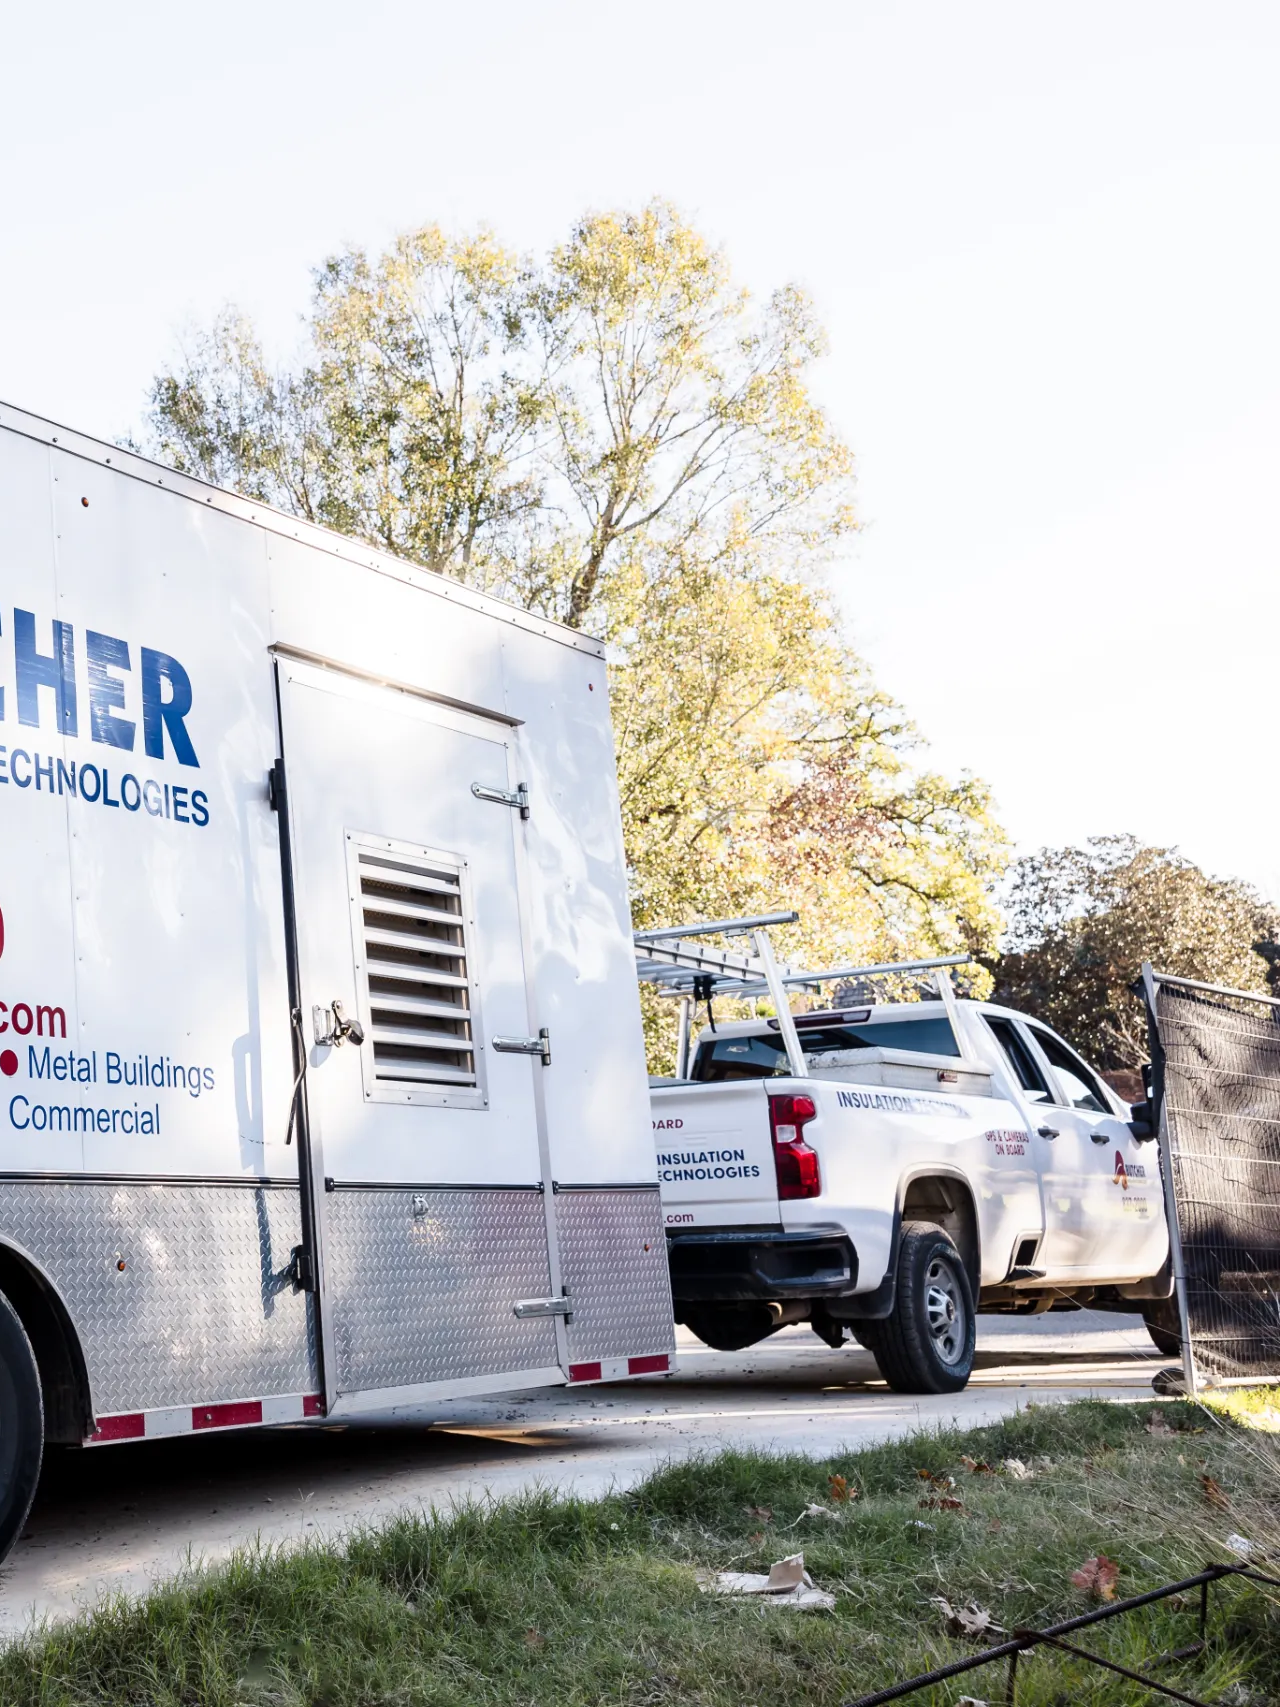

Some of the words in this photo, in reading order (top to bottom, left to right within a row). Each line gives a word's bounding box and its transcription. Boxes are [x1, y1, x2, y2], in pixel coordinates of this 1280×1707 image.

[27, 1040, 98, 1083] Metal
[105, 1051, 214, 1096] Buildings
[836, 1091, 913, 1112] INSULATION
[8, 1093, 160, 1135] Commercial
[652, 1119, 684, 1129] ARD
[656, 1149, 745, 1165] INSULATION
[657, 1166, 760, 1182] ECHNOLOGIES
